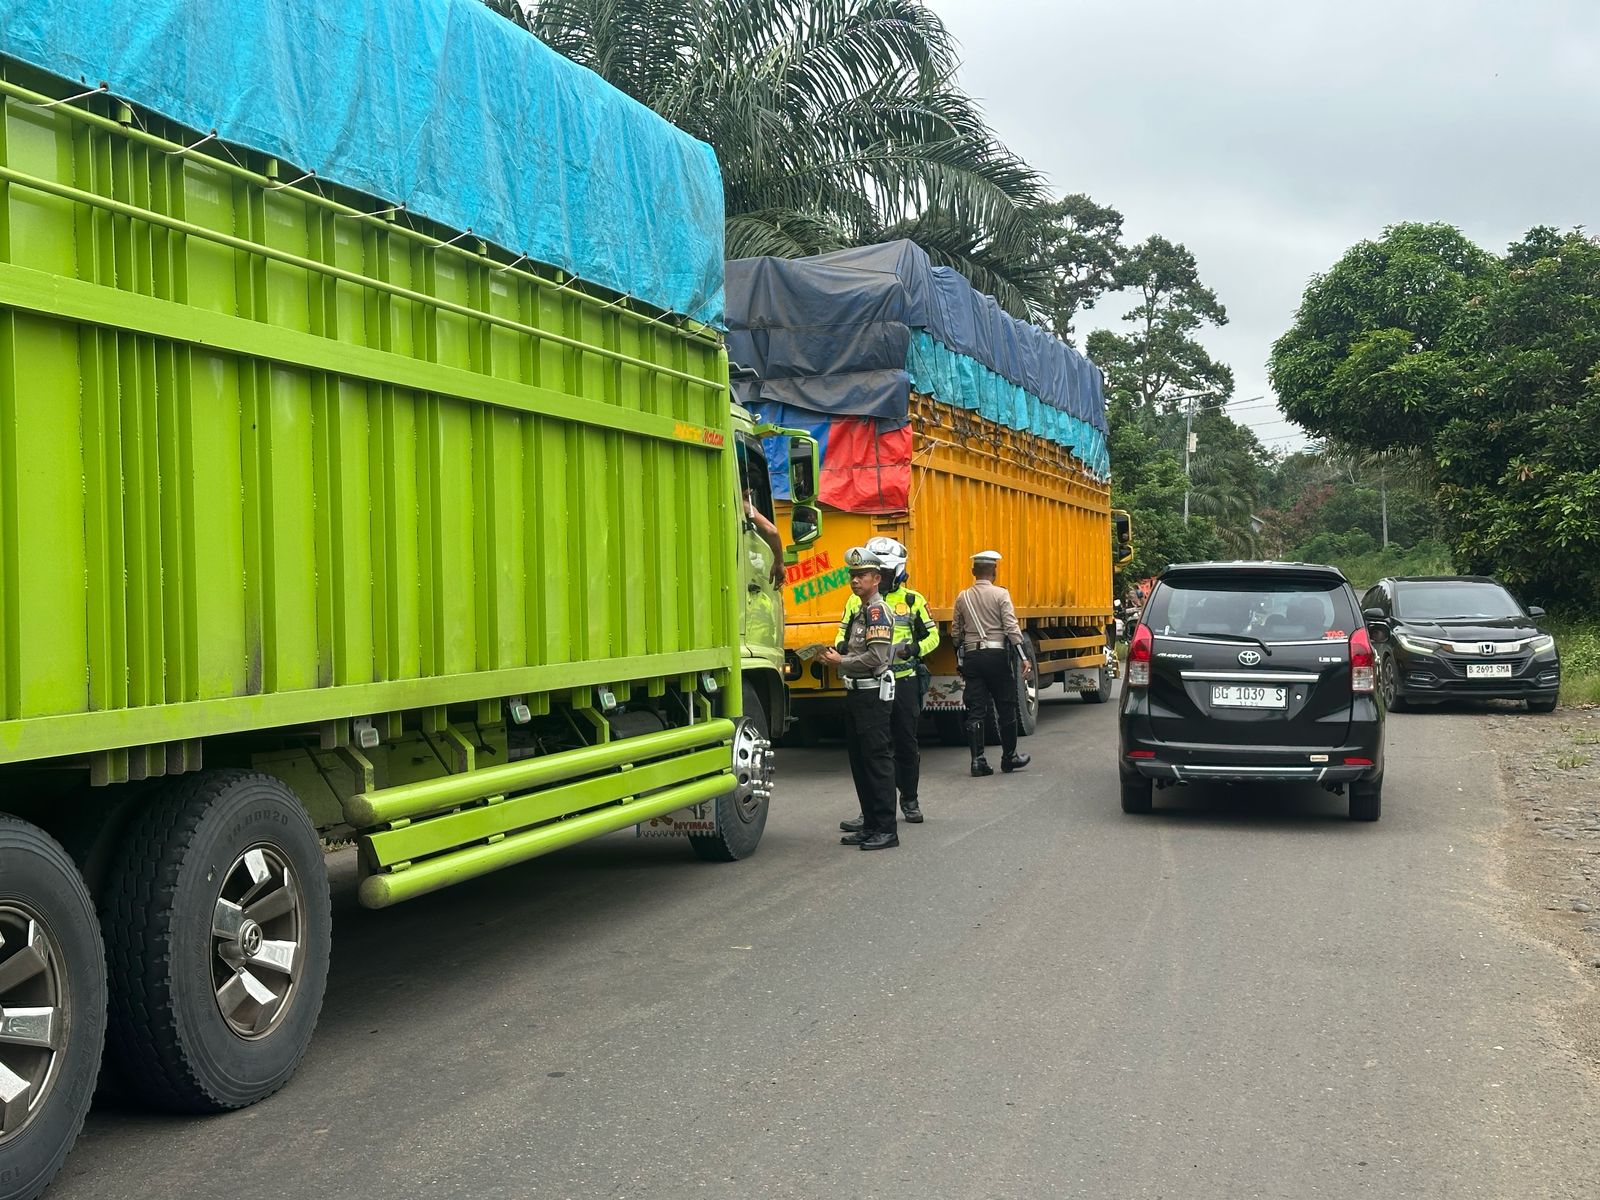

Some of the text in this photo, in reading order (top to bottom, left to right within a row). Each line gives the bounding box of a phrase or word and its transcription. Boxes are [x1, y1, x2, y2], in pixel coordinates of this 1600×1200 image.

[785, 551, 831, 585] DEN
[1468, 665, 1474, 674] B
[1496, 665, 1510, 673] SMA
[1213, 687, 1283, 701] BG 1039 S
